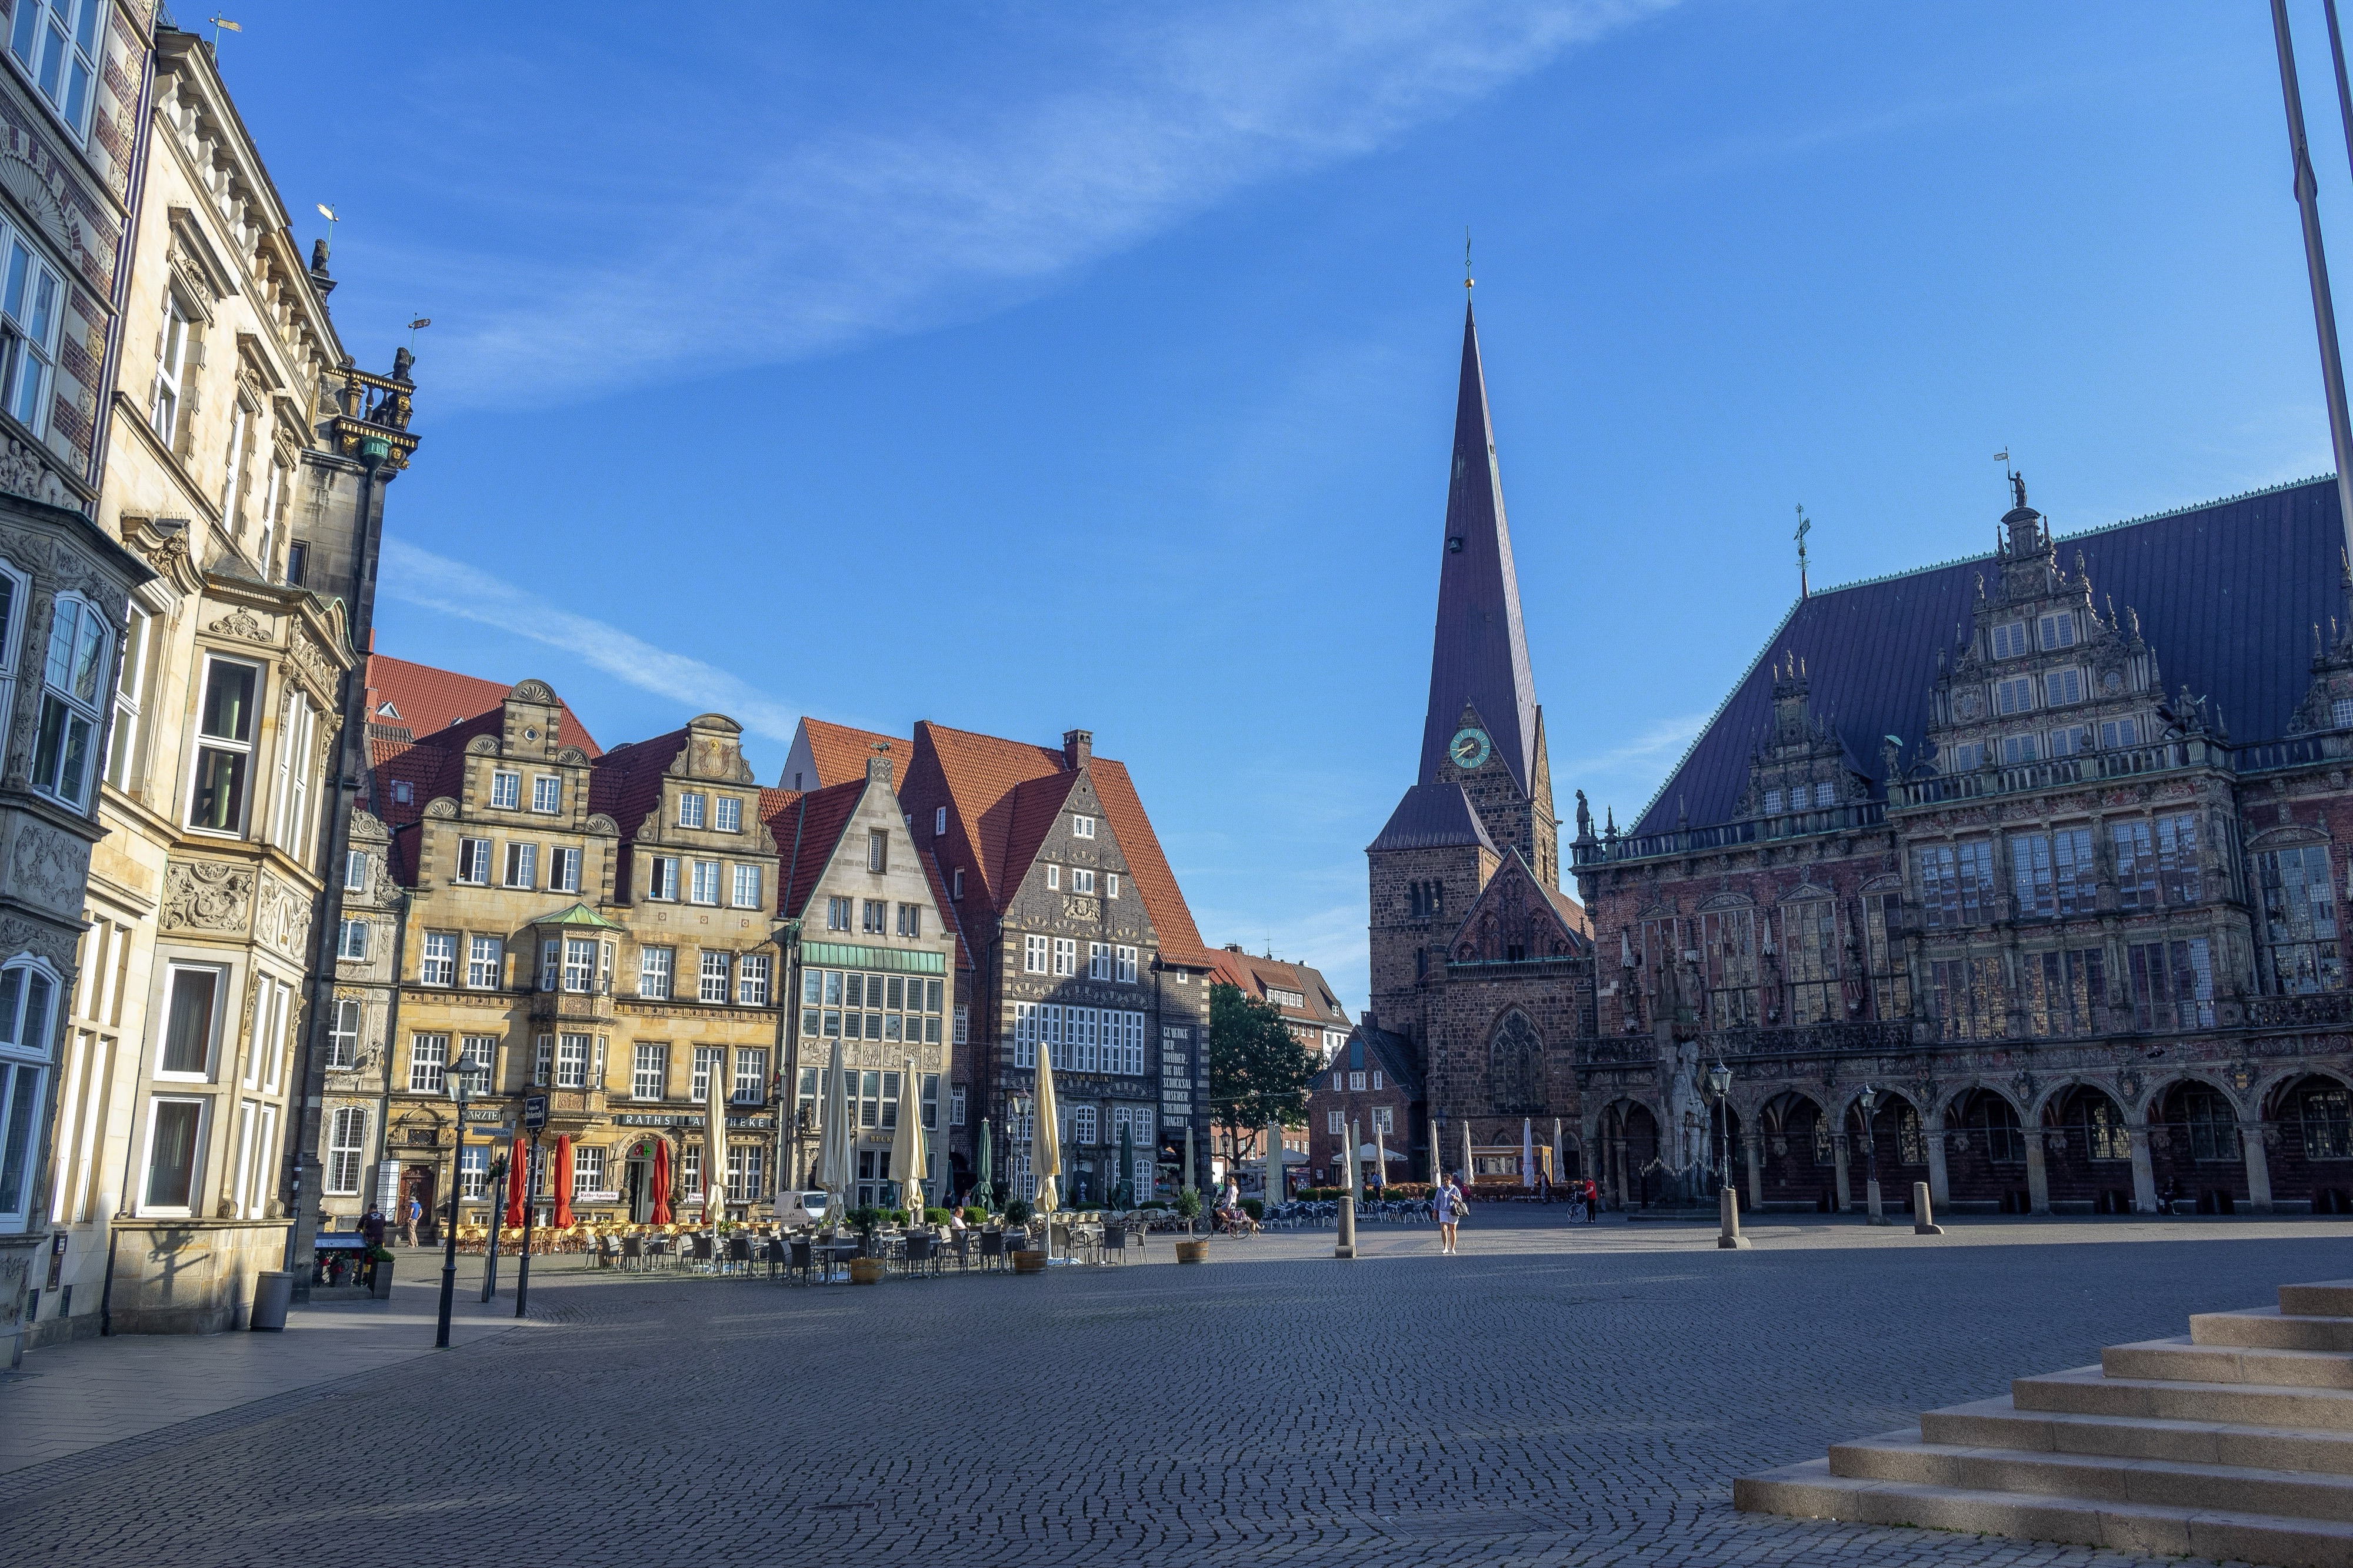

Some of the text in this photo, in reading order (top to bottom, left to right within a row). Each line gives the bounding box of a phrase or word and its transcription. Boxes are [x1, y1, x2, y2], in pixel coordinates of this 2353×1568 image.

[1163, 1039, 1174, 1050] DER
[1163, 1051, 1188, 1065] BRÜDER,
[1163, 1065, 1184, 1077] DIE DAS
[1162, 1077, 1192, 1089] SCHICKSAL
[1163, 1090, 1188, 1102] UNSERER
[468, 1110, 498, 1120] ÄRZTE
[1163, 1103, 1192, 1115] TRENNUNG
[626, 1115, 765, 1127] RATHS AHEKE
